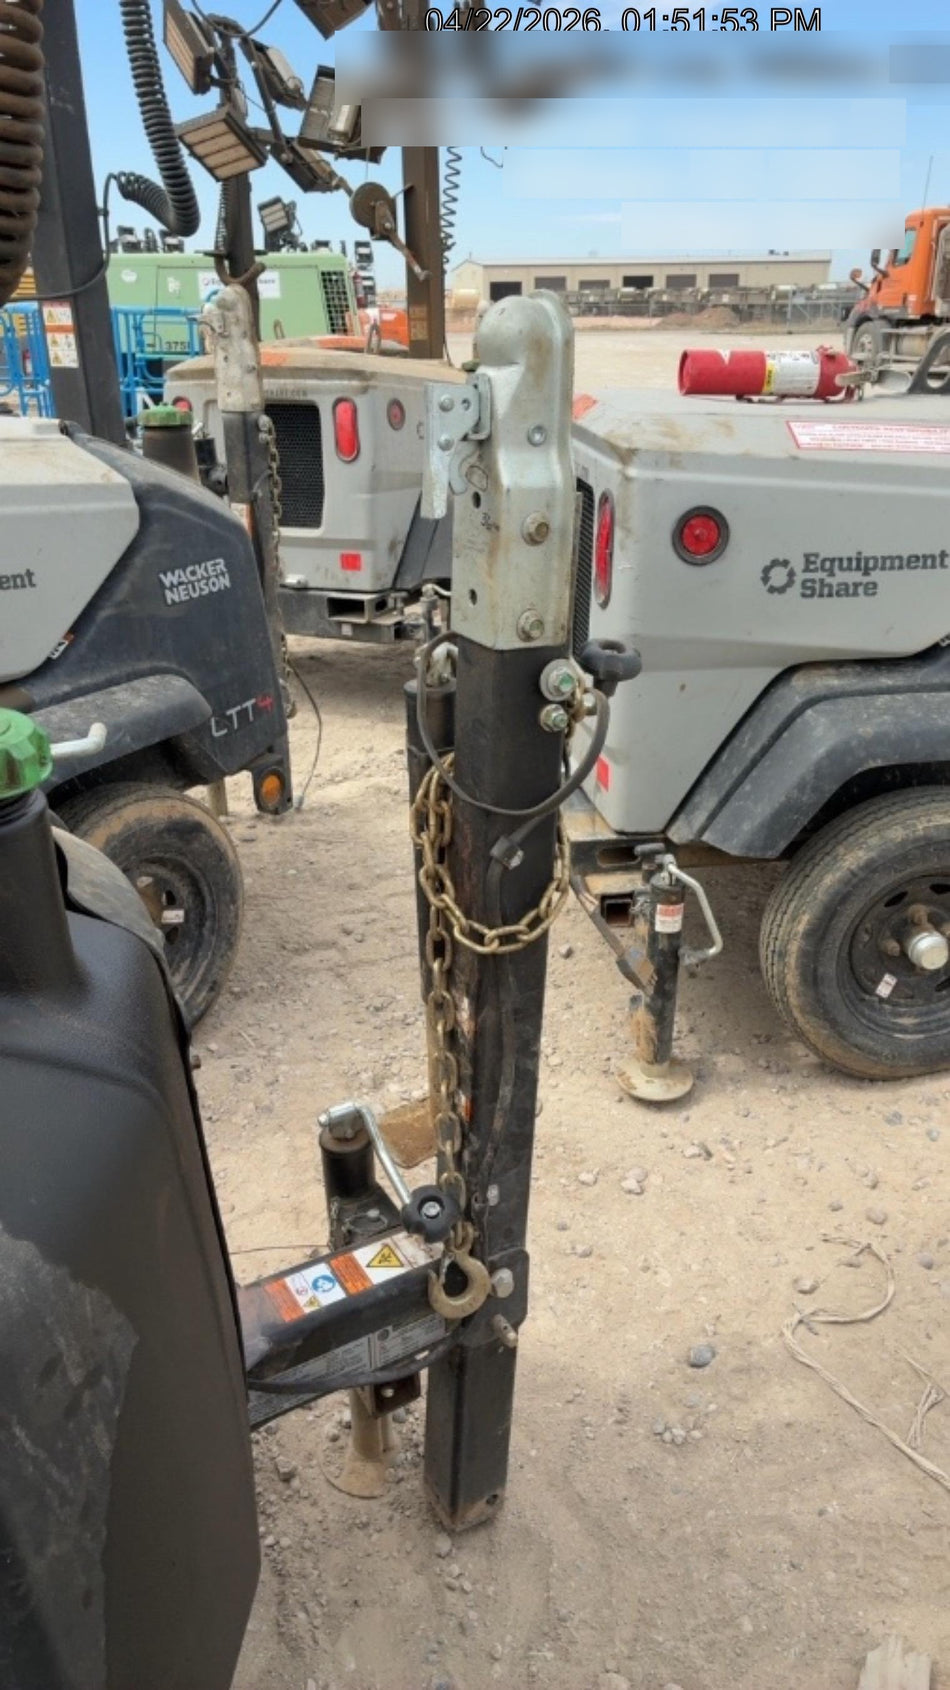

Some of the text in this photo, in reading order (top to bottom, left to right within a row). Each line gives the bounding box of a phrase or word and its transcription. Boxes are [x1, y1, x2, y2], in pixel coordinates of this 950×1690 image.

[159, 557, 228, 588] WACKER
[801, 549, 949, 577] Equipment
[165, 572, 231, 605] NEUSON
[800, 578, 879, 599] Share
[210, 694, 273, 737] LTT4
